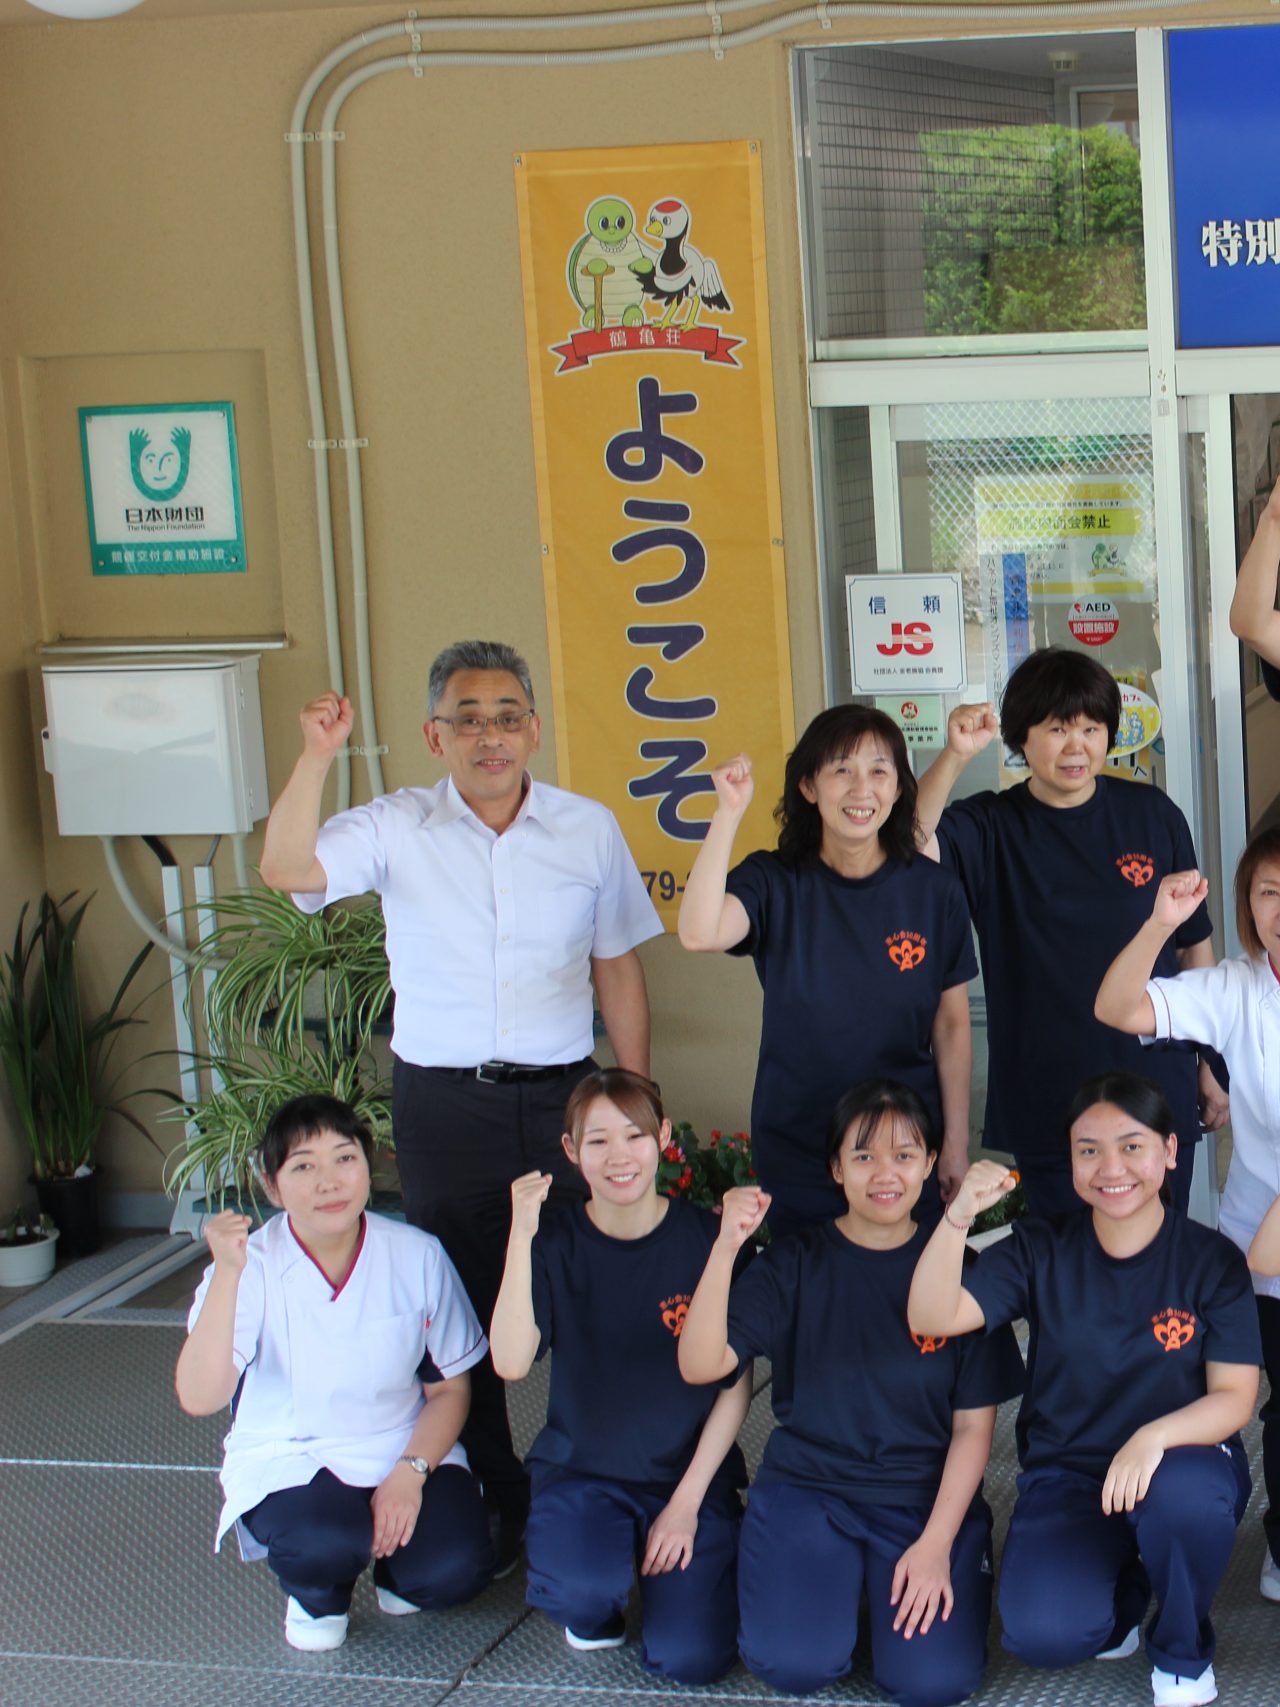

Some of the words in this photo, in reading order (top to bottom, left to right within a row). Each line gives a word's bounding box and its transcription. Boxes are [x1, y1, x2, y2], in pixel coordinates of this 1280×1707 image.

[608, 328, 682, 348] 鶴亀荘
[125, 506, 205, 523] 日本財団
[604, 375, 718, 843] ようこそ
[868, 595, 941, 615] 信頼
[1085, 602, 1111, 613] AED
[876, 621, 934, 656] JS
[640, 870, 691, 901] 79-
